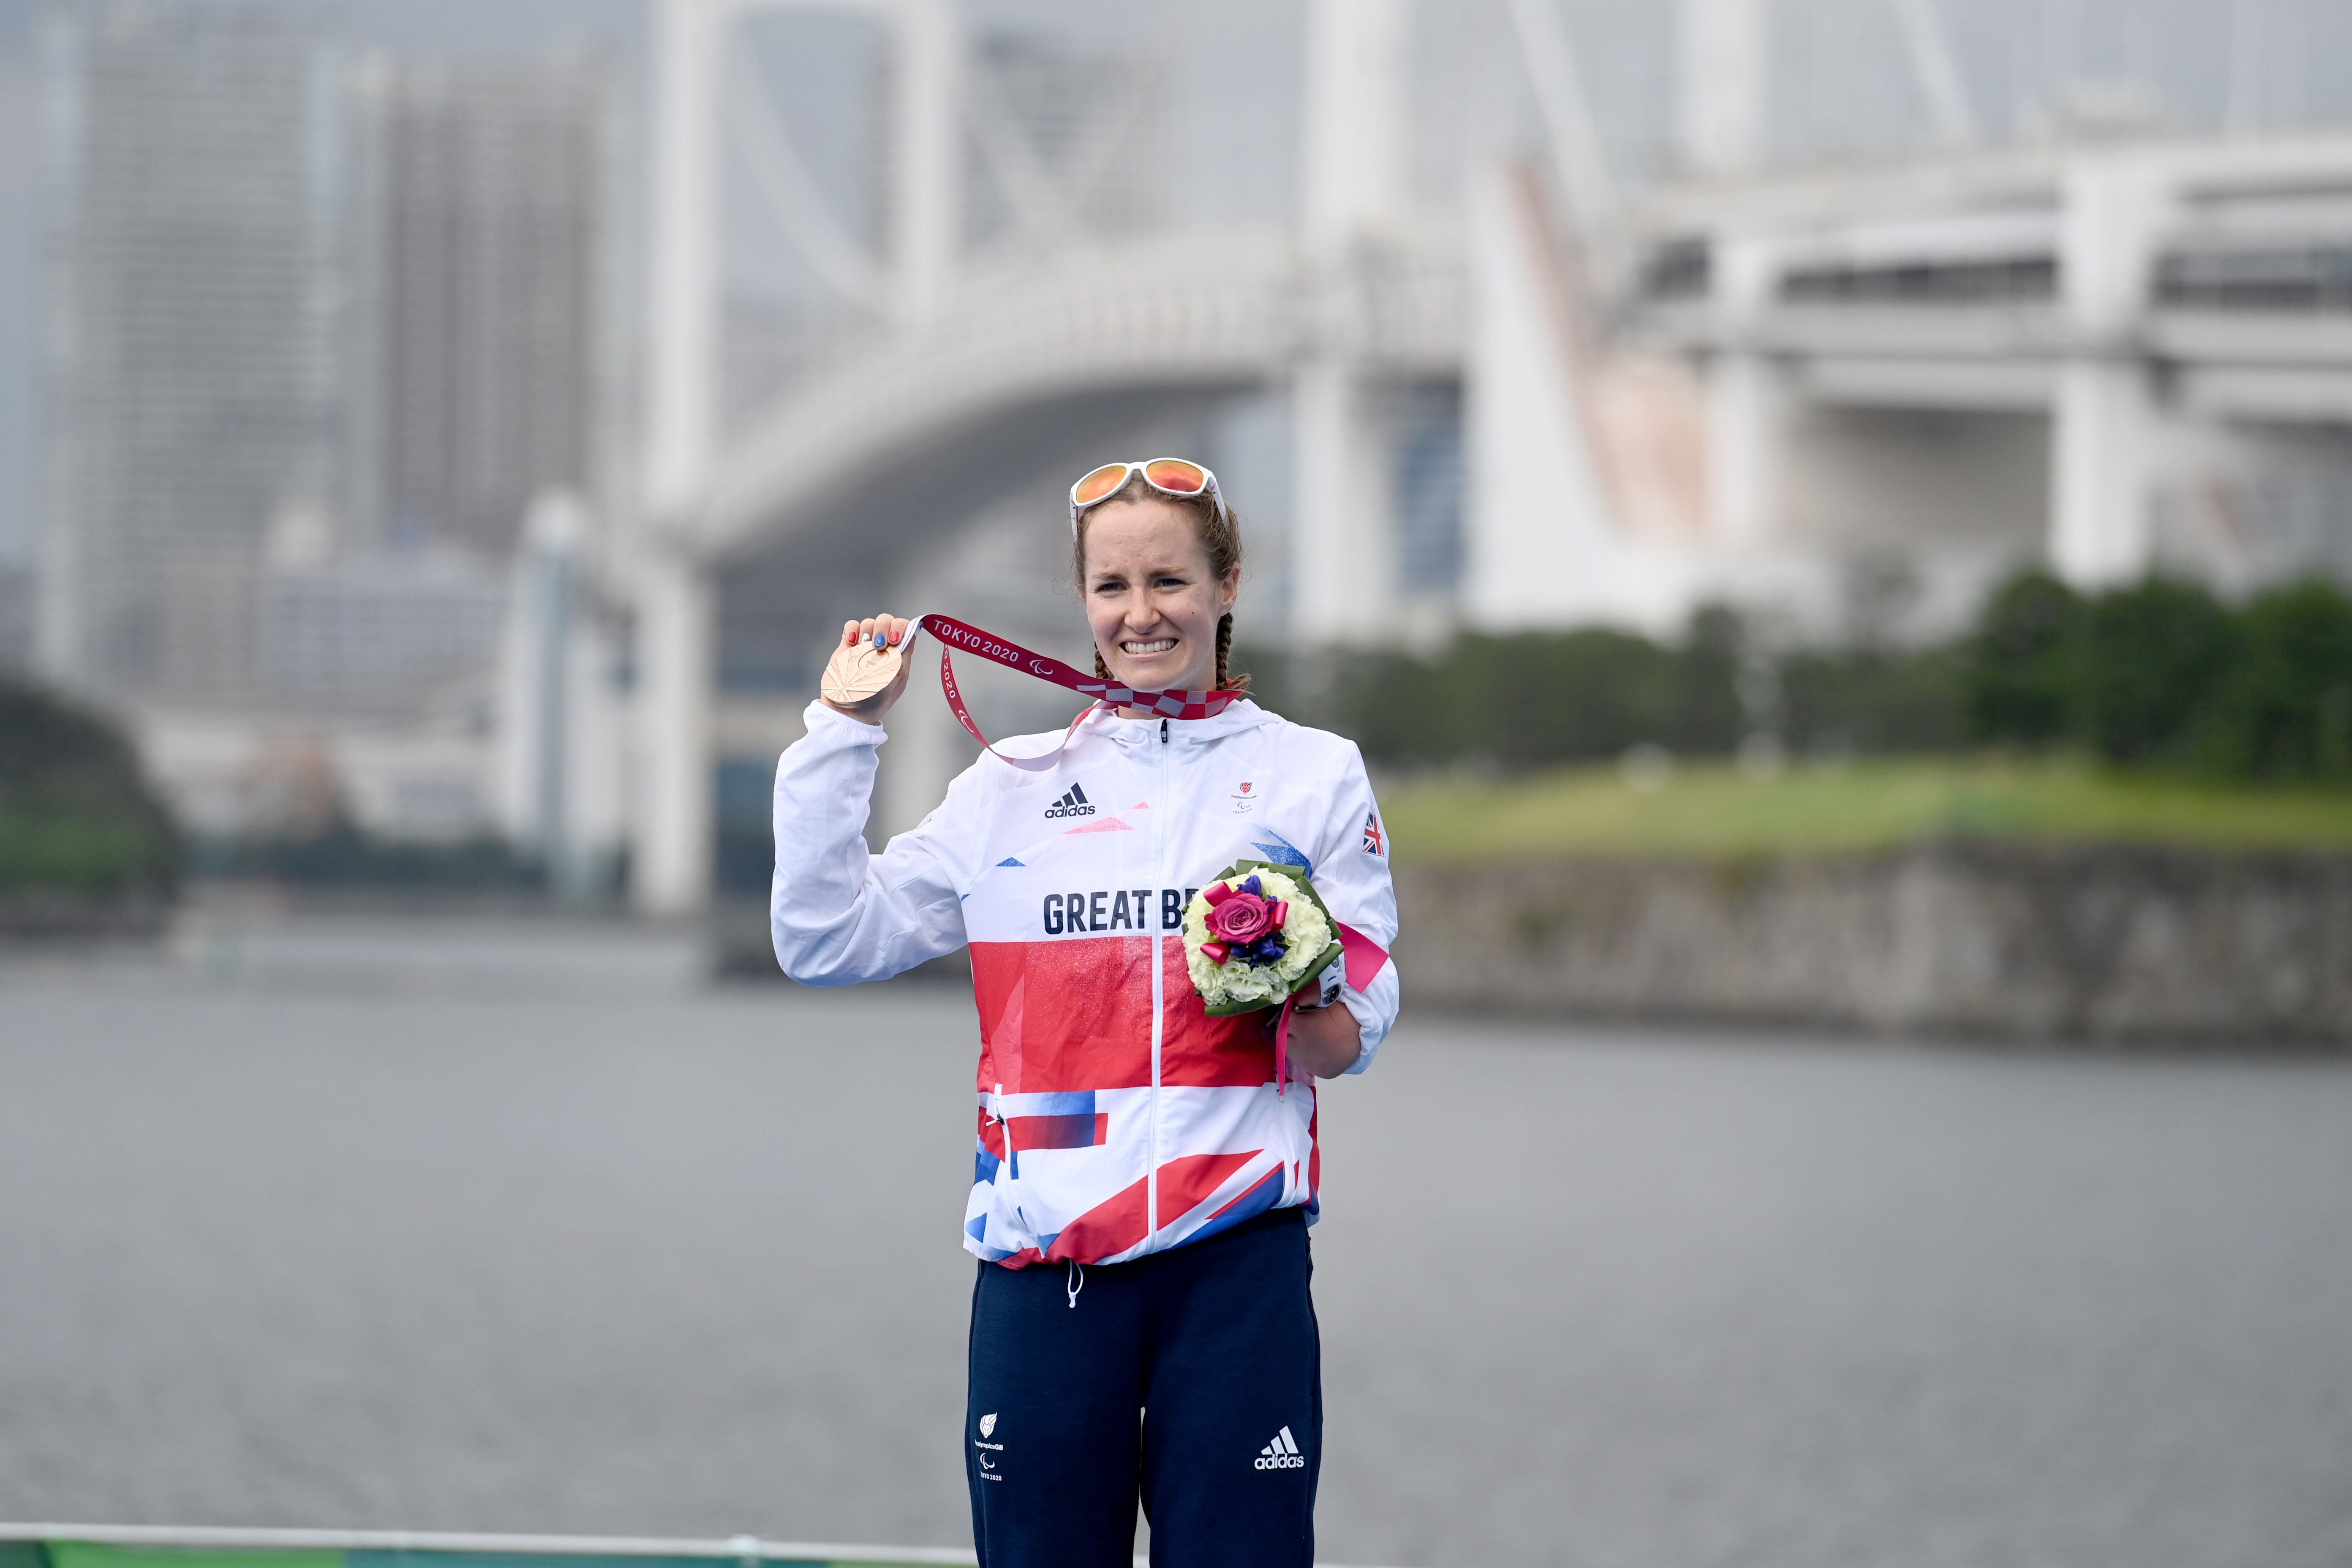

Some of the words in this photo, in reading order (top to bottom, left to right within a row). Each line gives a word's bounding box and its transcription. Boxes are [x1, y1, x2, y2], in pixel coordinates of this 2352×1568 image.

[934, 619, 980, 648] TOKYO
[982, 641, 1018, 662] 2020
[944, 662, 956, 699] 2020
[1045, 804, 1095, 818] adidas
[1044, 890, 1152, 934] GREAT
[1254, 1453, 1304, 1470] adidas
